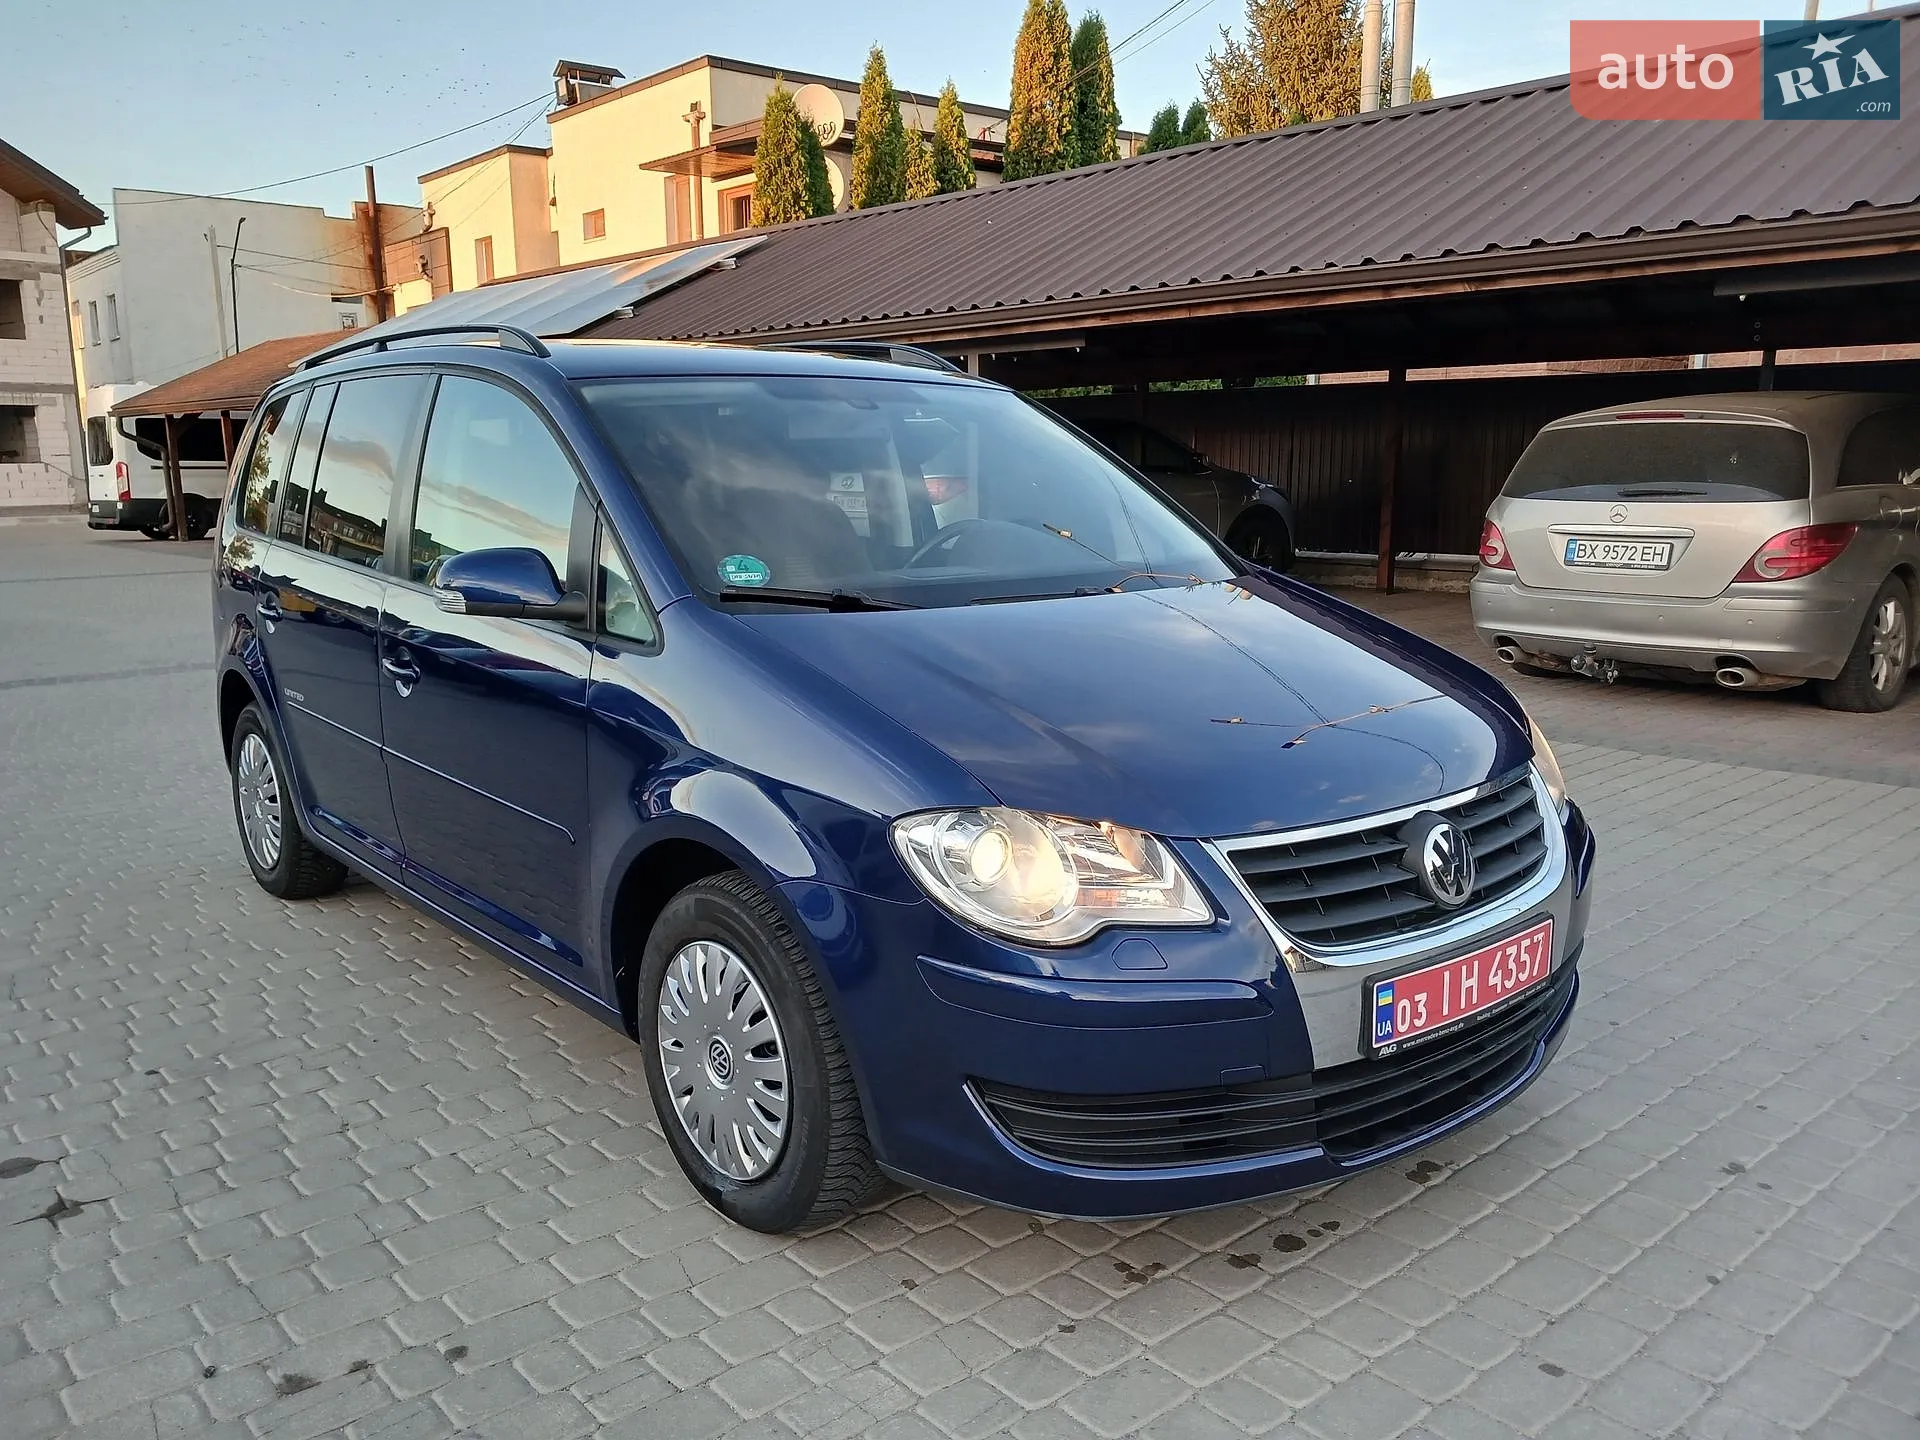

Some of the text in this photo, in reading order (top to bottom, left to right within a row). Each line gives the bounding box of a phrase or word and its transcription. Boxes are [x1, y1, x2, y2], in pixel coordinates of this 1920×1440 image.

[1576, 543, 1665, 562] BX 9572 EH
[1396, 992, 1428, 1033] 03
[1488, 931, 1545, 994] 4357
[1377, 1020, 1393, 1036] UA
